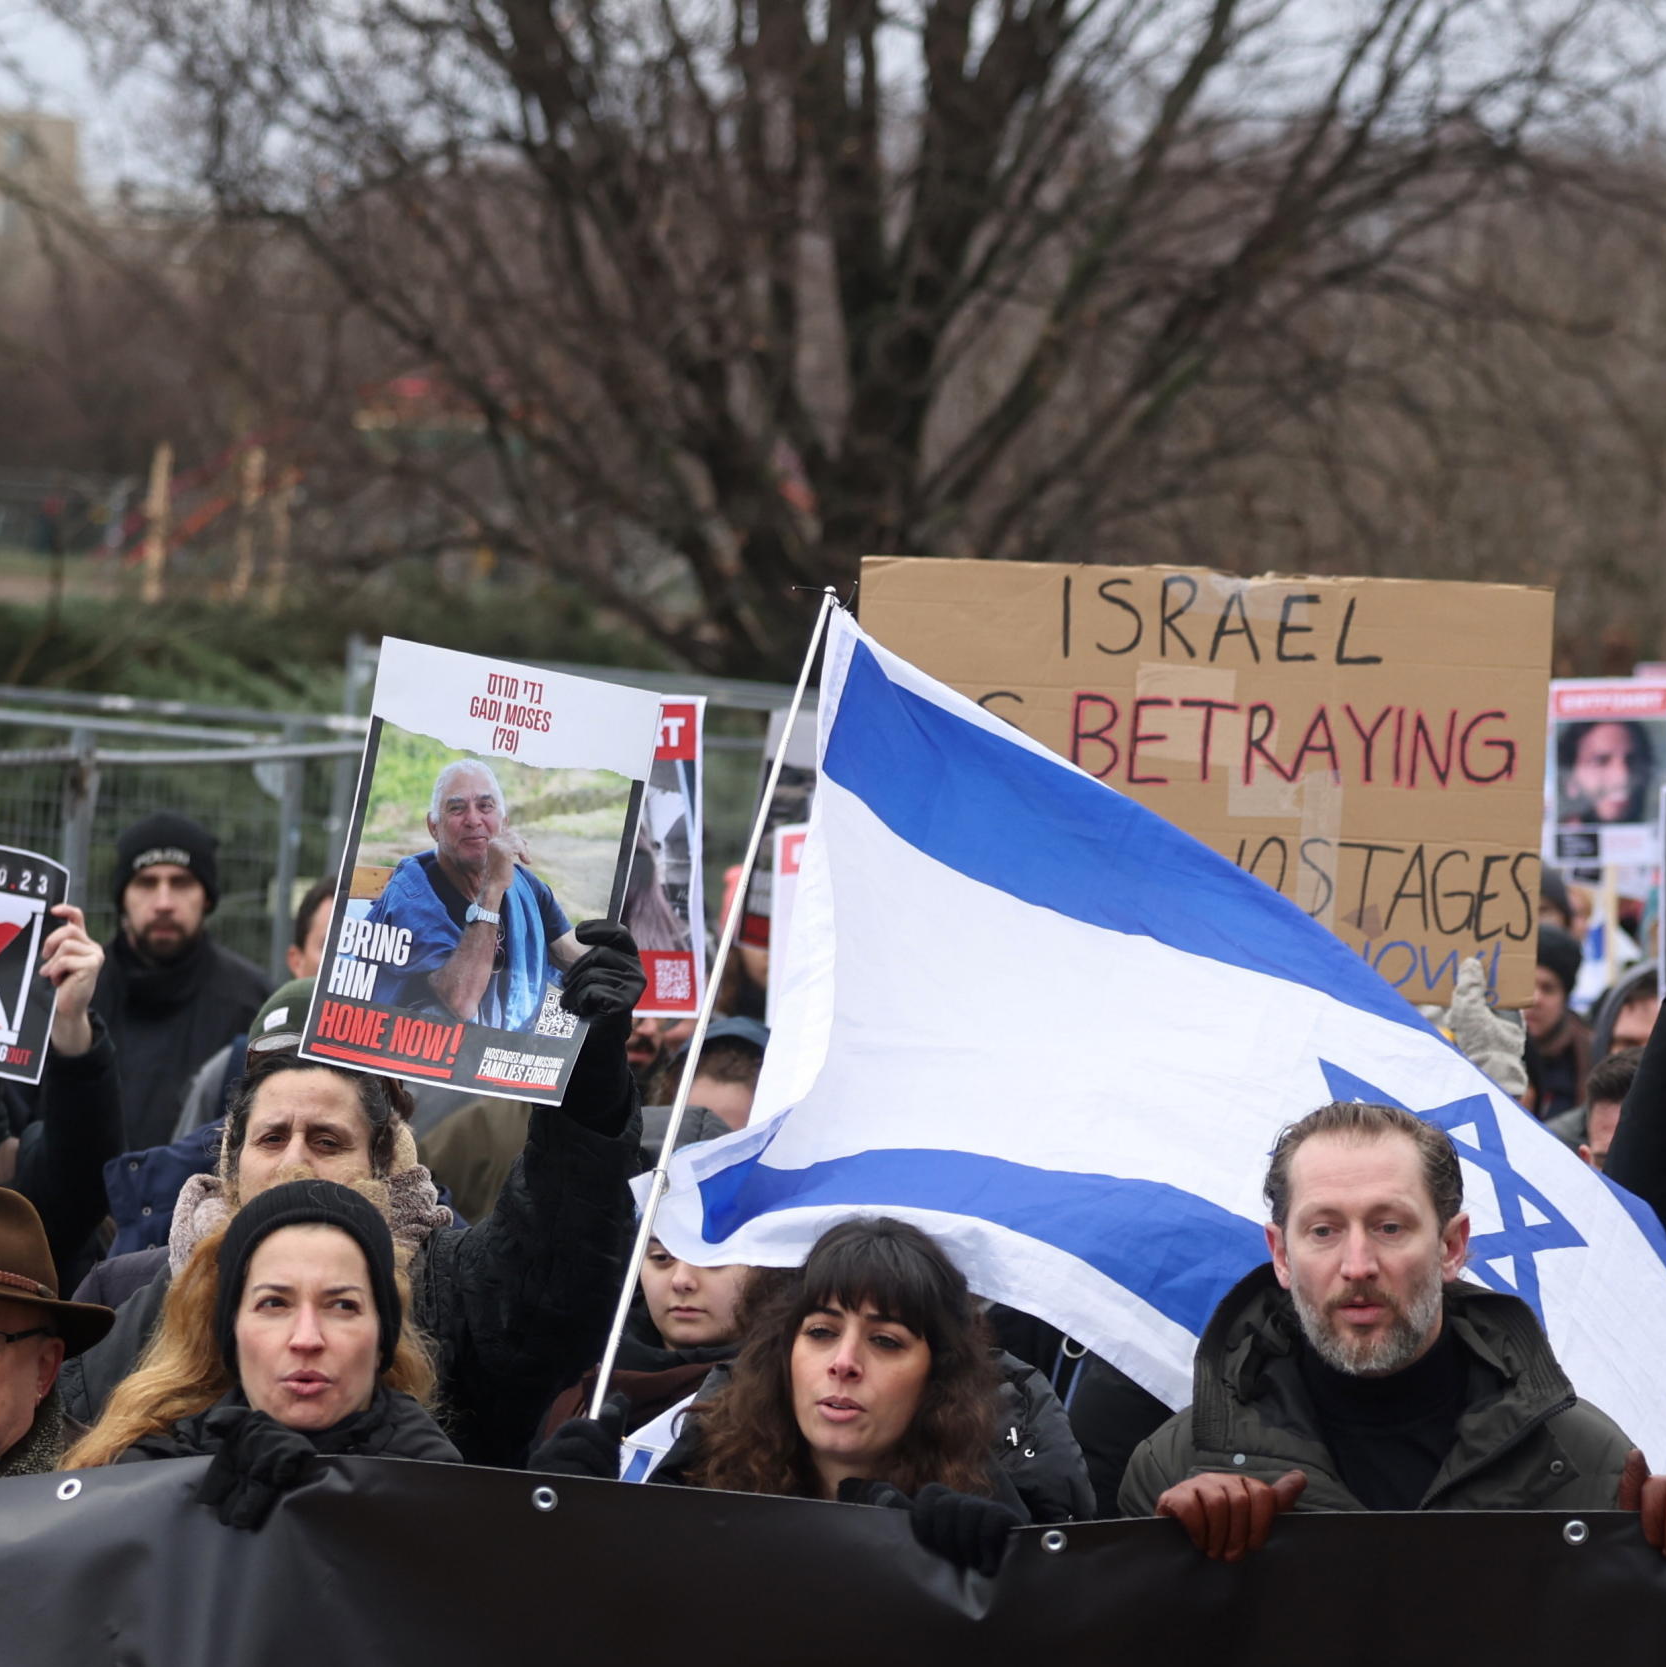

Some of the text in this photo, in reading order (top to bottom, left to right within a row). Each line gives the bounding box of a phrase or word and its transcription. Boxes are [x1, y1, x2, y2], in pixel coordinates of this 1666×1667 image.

[1062, 575, 1383, 664] ISRAEL
[487, 673, 543, 705] גדי מוזס
[469, 696, 552, 733] GADI MOSES
[492, 726, 520, 755] (79)
[1069, 690, 1518, 789] BETRAYING
[1237, 836, 1541, 941] OSTAGES
[336, 915, 413, 967] BRING
[327, 956, 378, 1002] HIM
[1361, 940, 1501, 1007] OW!
[316, 1000, 465, 1065] HOME NOW!
[478, 1059, 561, 1087] FAMILIES FORUM
[484, 1047, 564, 1070] HOSTAGES AND MISSING
